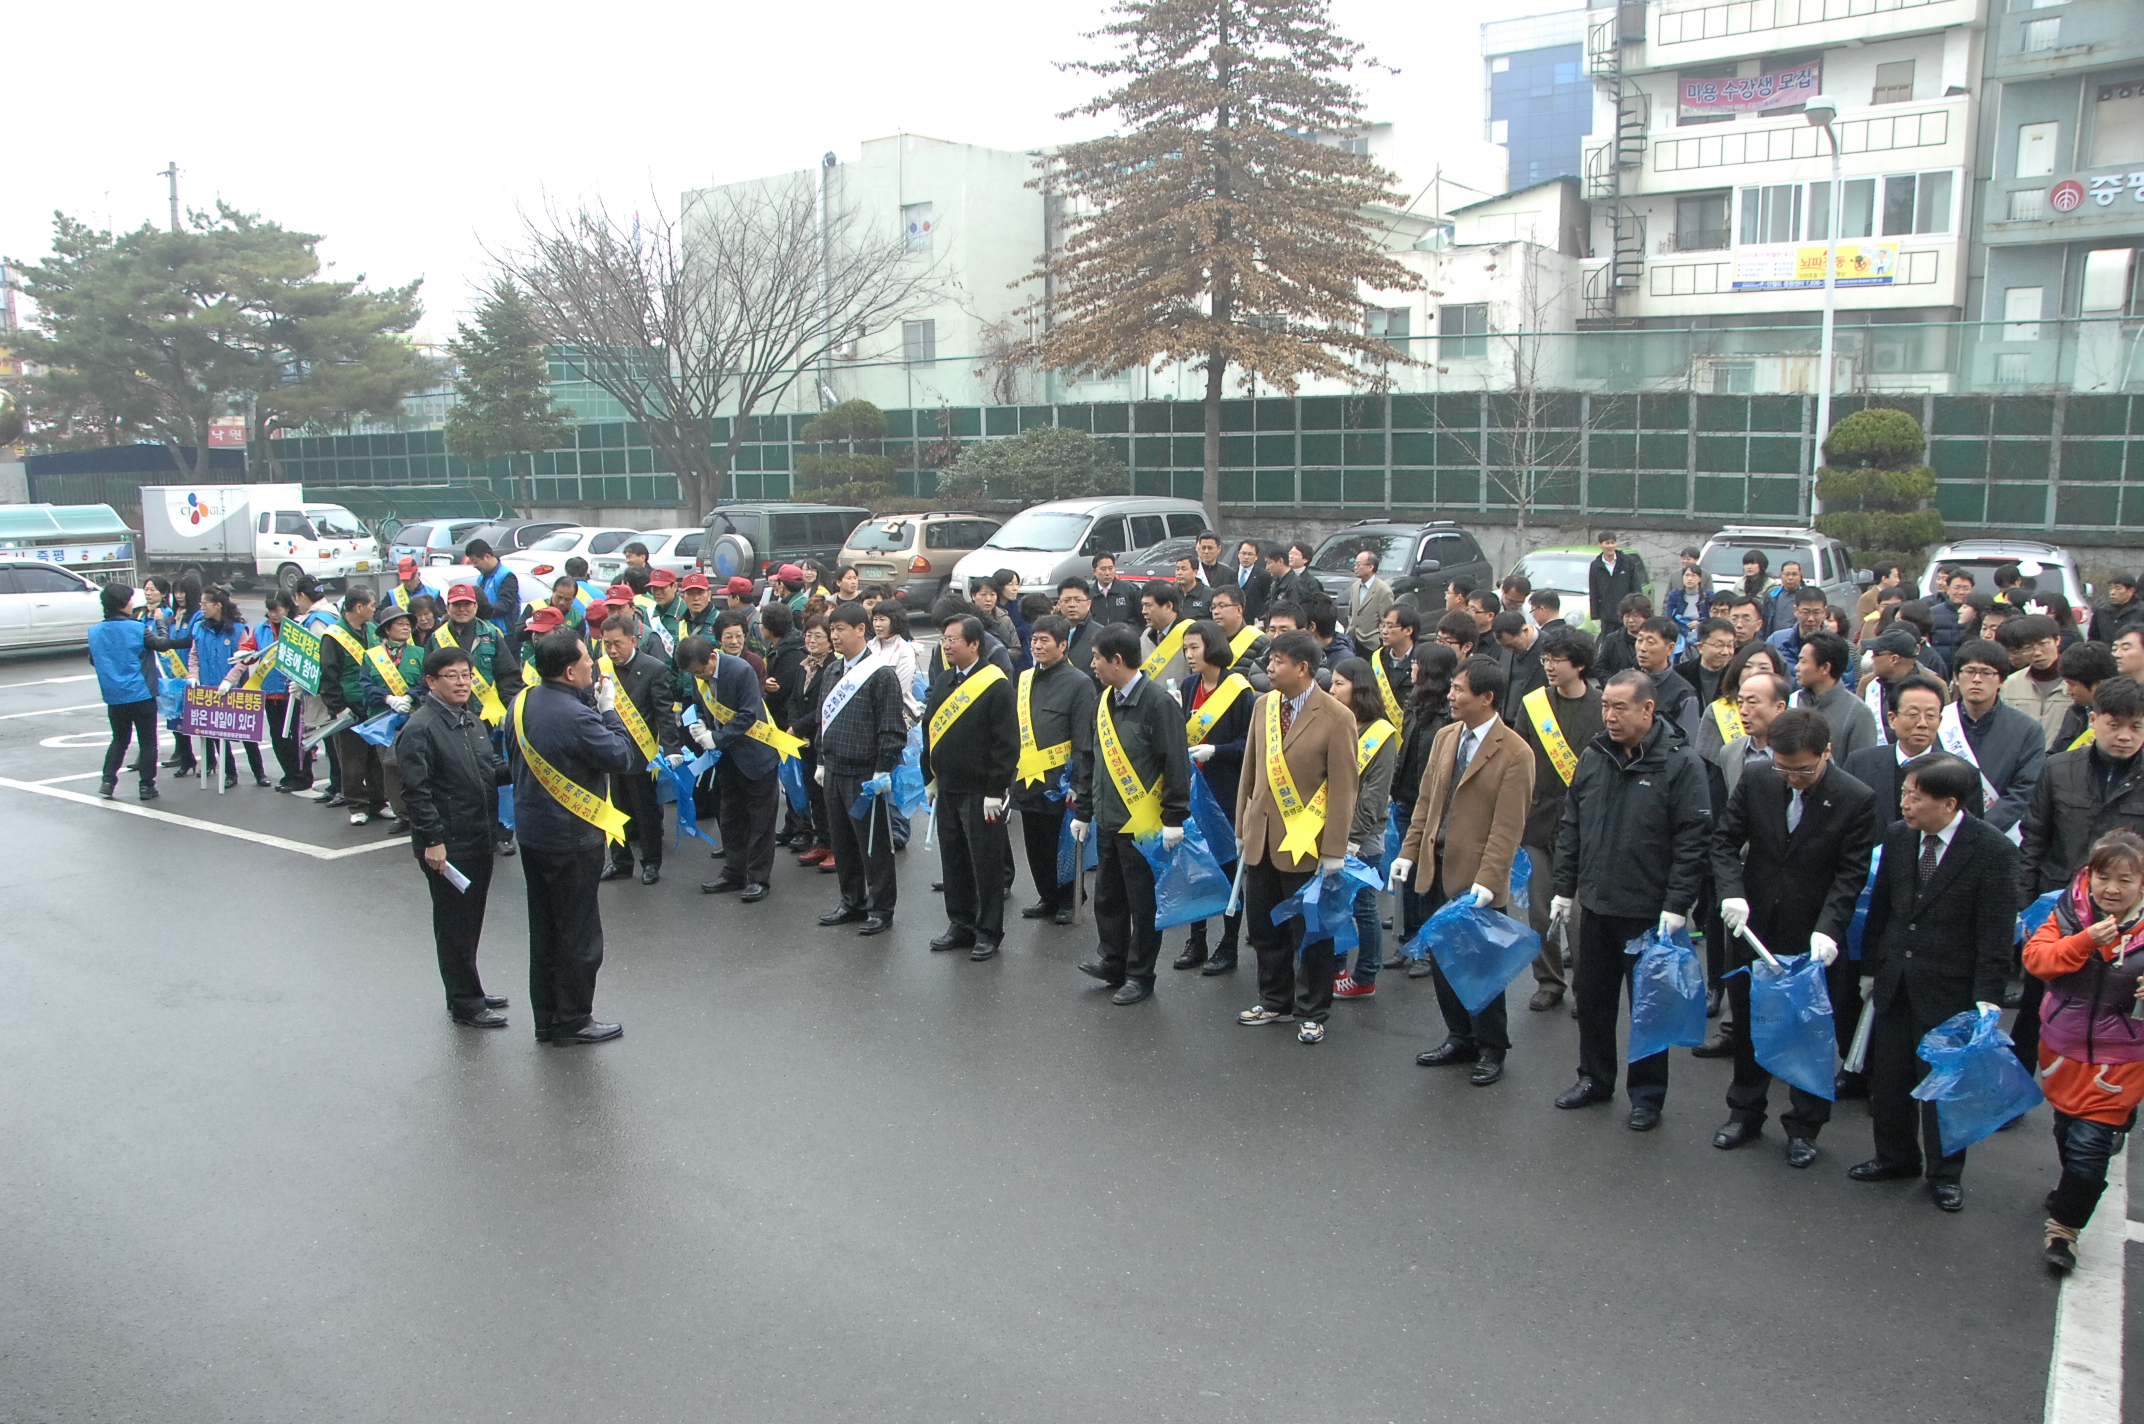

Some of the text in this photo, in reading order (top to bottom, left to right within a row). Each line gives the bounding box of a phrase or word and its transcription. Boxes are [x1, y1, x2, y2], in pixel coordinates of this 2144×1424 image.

[1687, 67, 1813, 102] 미용 수강생 모집
[1800, 255, 1846, 269] 뇌파동
[180, 506, 191, 517] CJ
[278, 642, 302, 673] 활동에
[302, 658, 320, 685] 참여
[227, 691, 262, 711] 바른행동
[190, 709, 256, 732] 밝은 내일이 있다
[1552, 730, 1577, 769] 깨끗하고
[1550, 748, 1573, 780] 생활환
[571, 802, 592, 818] 조성
[1282, 804, 1303, 818] 증평군
